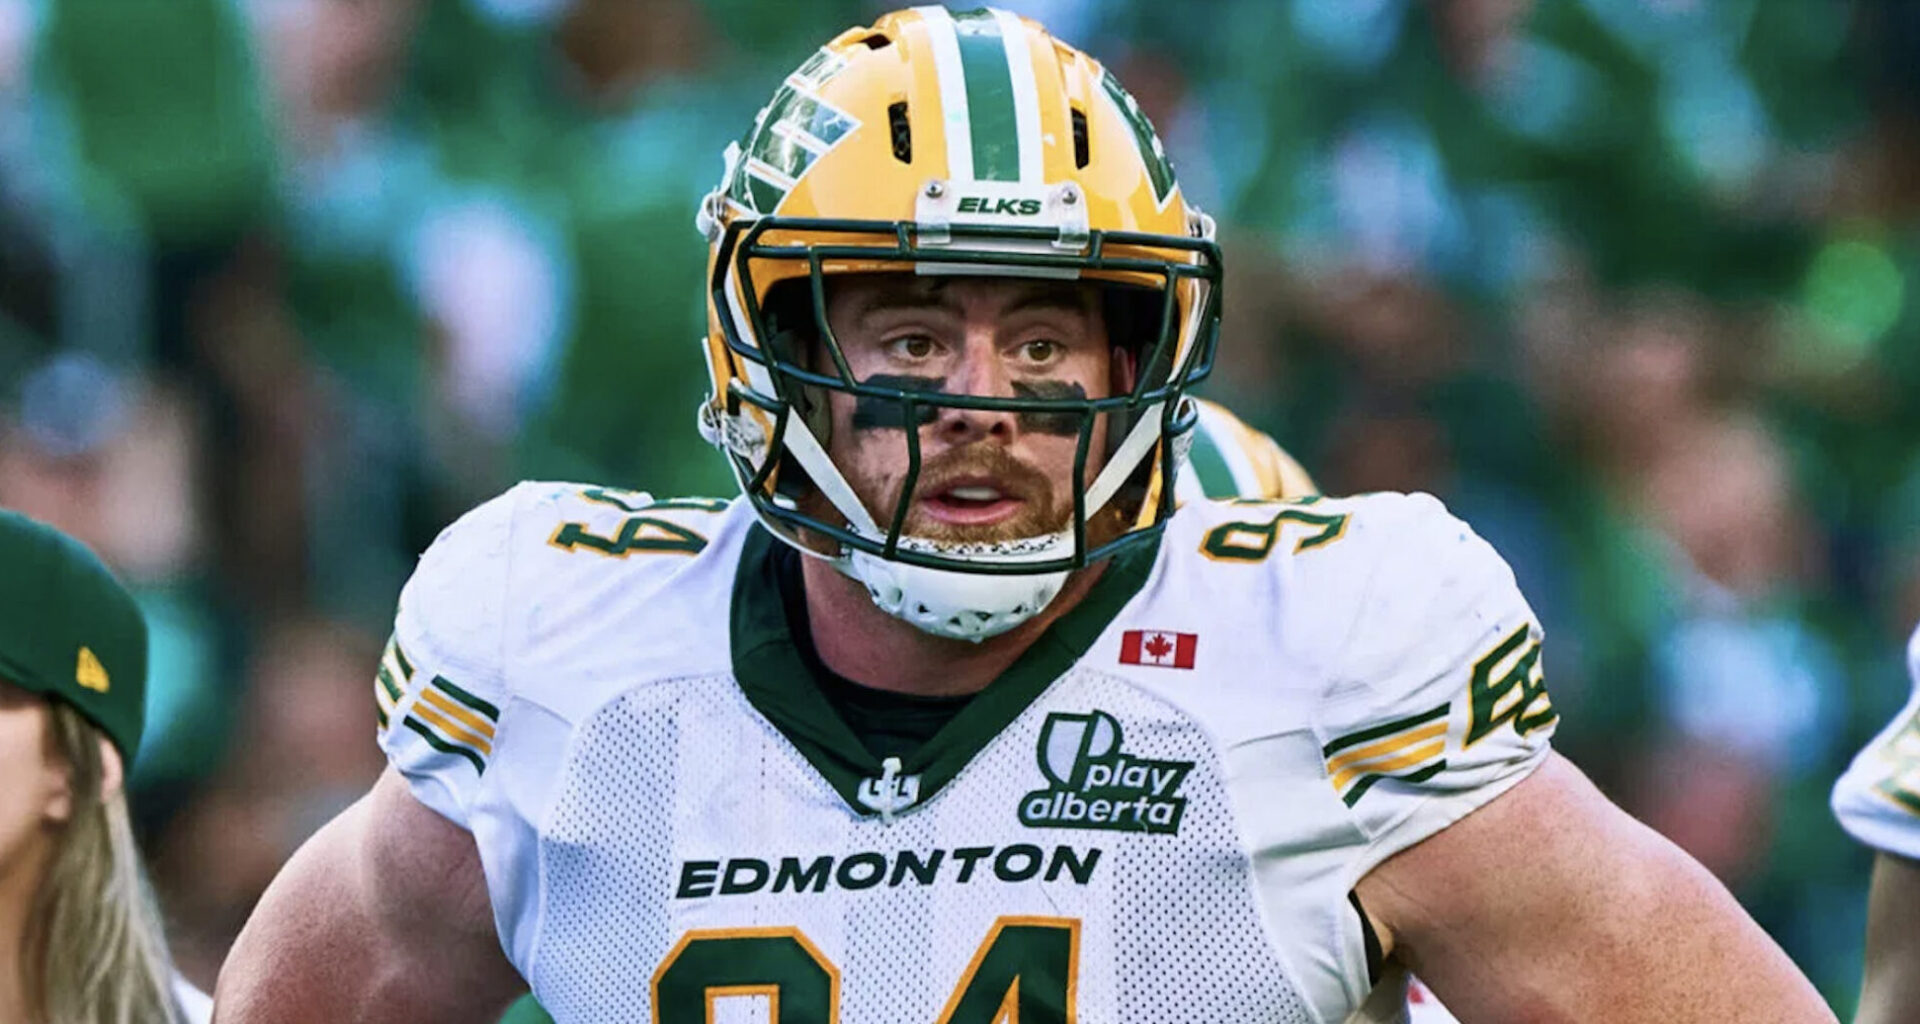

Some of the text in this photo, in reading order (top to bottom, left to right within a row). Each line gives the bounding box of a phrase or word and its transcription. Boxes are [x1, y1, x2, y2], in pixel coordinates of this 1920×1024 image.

[957, 197, 1042, 216] ELKS
[1082, 759, 1178, 796] play
[1026, 791, 1176, 825] alberta
[675, 843, 1102, 900] EDMONTON
